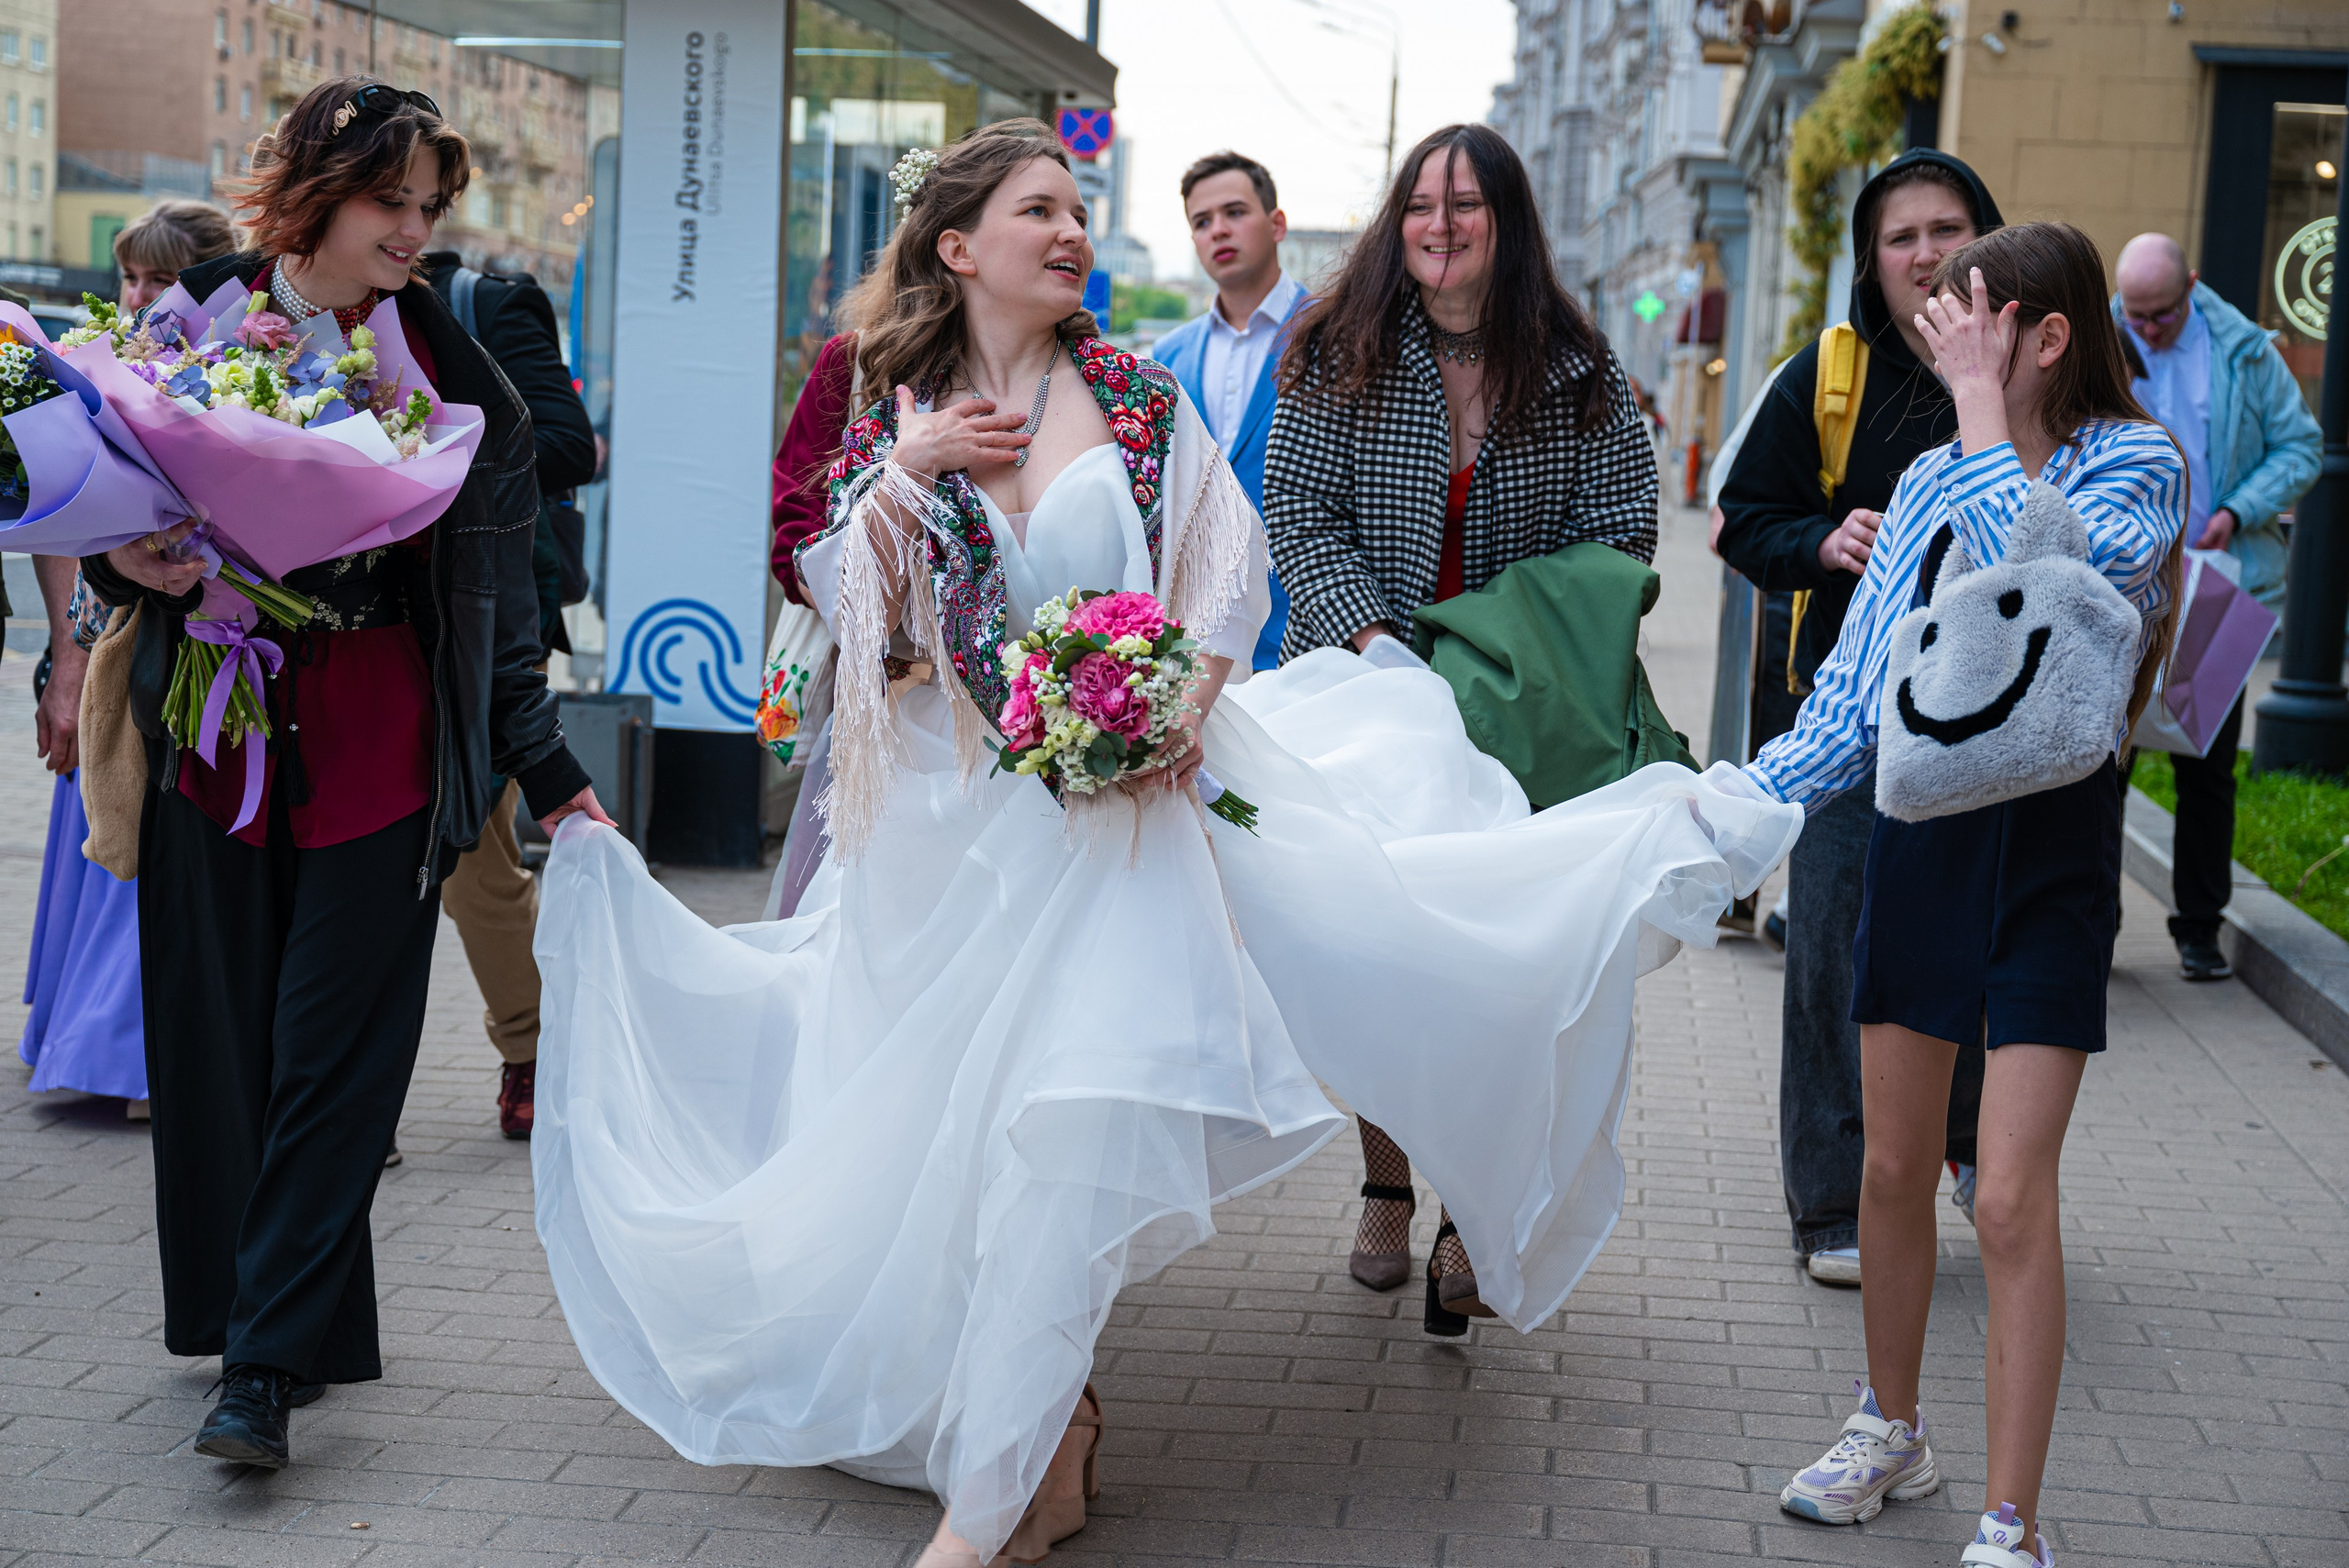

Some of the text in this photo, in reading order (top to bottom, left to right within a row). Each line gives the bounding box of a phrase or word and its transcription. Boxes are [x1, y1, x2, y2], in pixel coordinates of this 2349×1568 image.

[671, 30, 705, 302] Улица Дунаевского
[704, 31, 731, 217] Ulitsa Dunaevskogo
